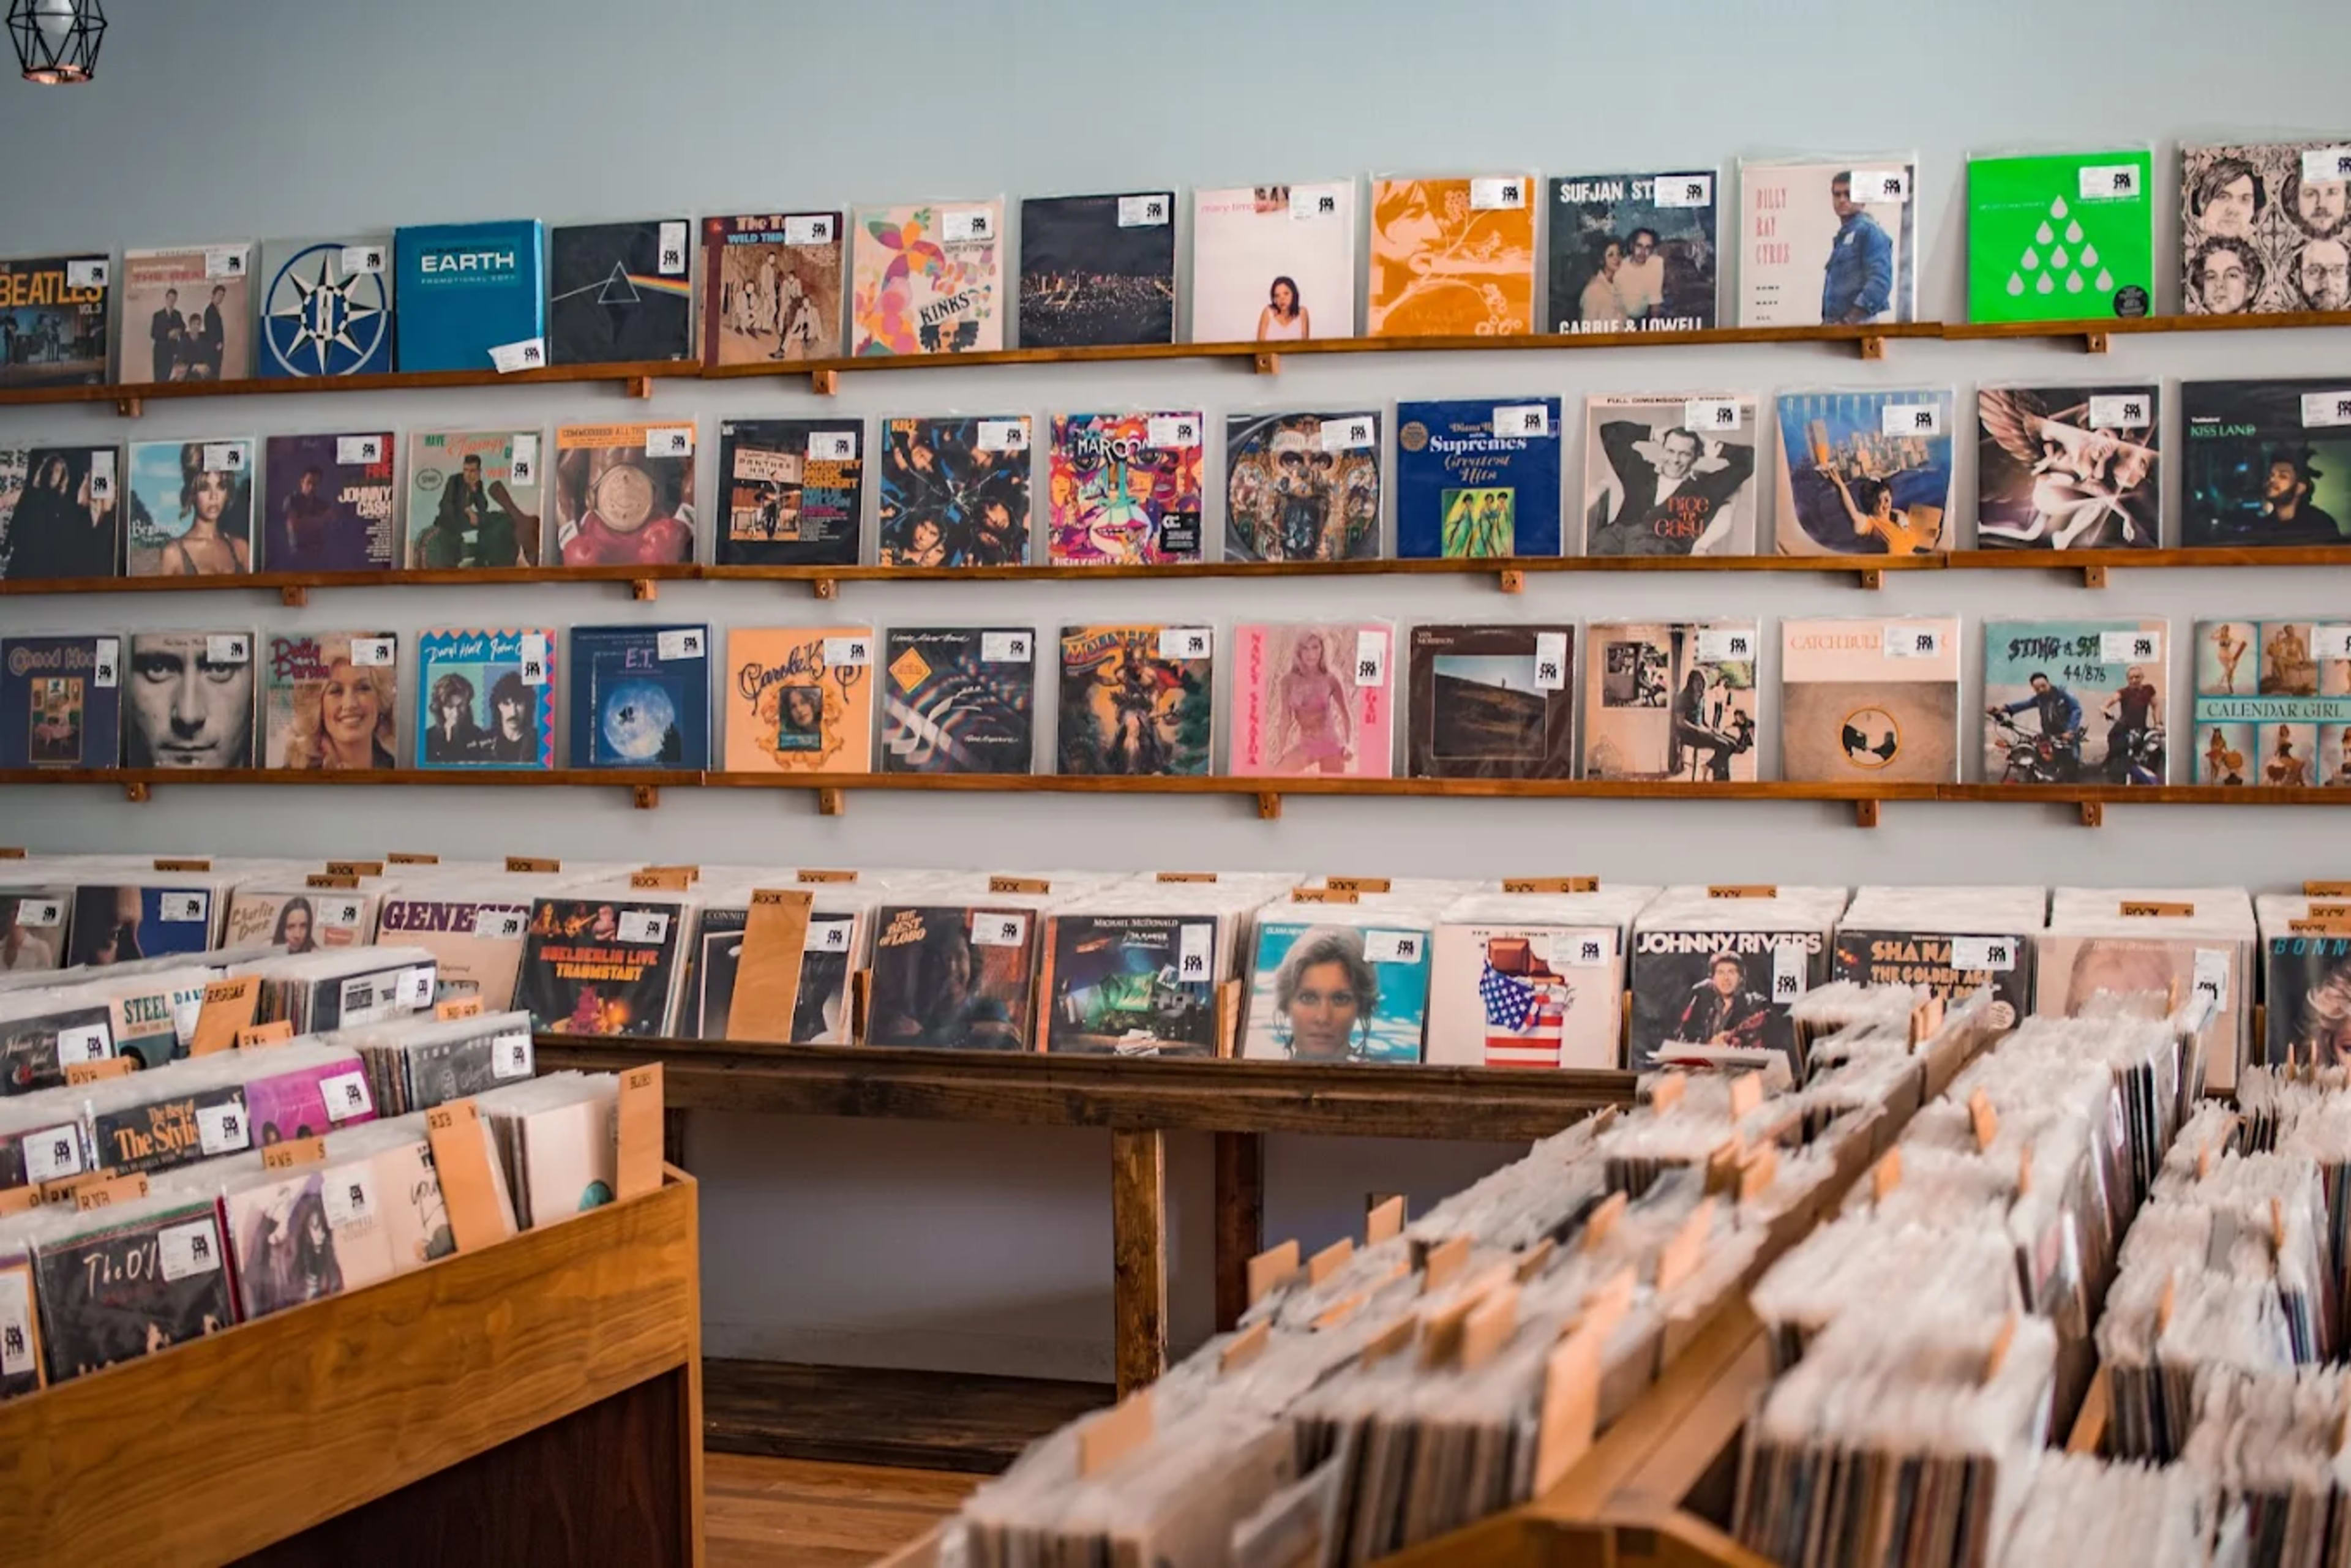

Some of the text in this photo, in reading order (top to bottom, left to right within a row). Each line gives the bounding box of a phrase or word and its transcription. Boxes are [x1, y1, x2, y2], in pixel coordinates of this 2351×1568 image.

[1560, 183, 1622, 203] SUFJAN
[727, 234, 759, 244] WILD
[421, 252, 515, 273] EARTH
[920, 291, 970, 325] KINKS
[2190, 424, 2256, 438] KISS LAND
[1429, 436, 1527, 455] Supremes
[1444, 455, 1511, 471] Greatest
[1460, 466, 1498, 482] Hits
[338, 486, 392, 503] JOHNNY
[356, 501, 392, 517] CASH
[1667, 496, 1709, 514] nice
[1654, 518, 1704, 539] easy
[459, 640, 484, 659] Hall
[625, 647, 654, 669] E.T.
[2008, 636, 2061, 662] STING
[738, 646, 803, 716] Carole
[2063, 664, 2107, 683] 44/876
[2207, 702, 2344, 718] CALENDAR GIRL
[508, 861, 531, 872] ROCK
[631, 876, 659, 888] ROCK
[991, 881, 1019, 893] ROCK
[752, 893, 781, 906] ROCK
[706, 911, 746, 920] CONNI
[894, 910, 917, 922] THE
[887, 917, 923, 936] BEST
[888, 928, 927, 945] LOBO
[1637, 933, 1735, 953] JOHNNY
[626, 950, 659, 966] LIVE
[1870, 940, 1952, 962] SHA NA
[1870, 966, 1900, 982] THE
[1902, 966, 1960, 983] GOLDEN
[124, 994, 170, 1024] STEEL
[114, 1127, 153, 1161] The
[83, 1251, 122, 1298] The
